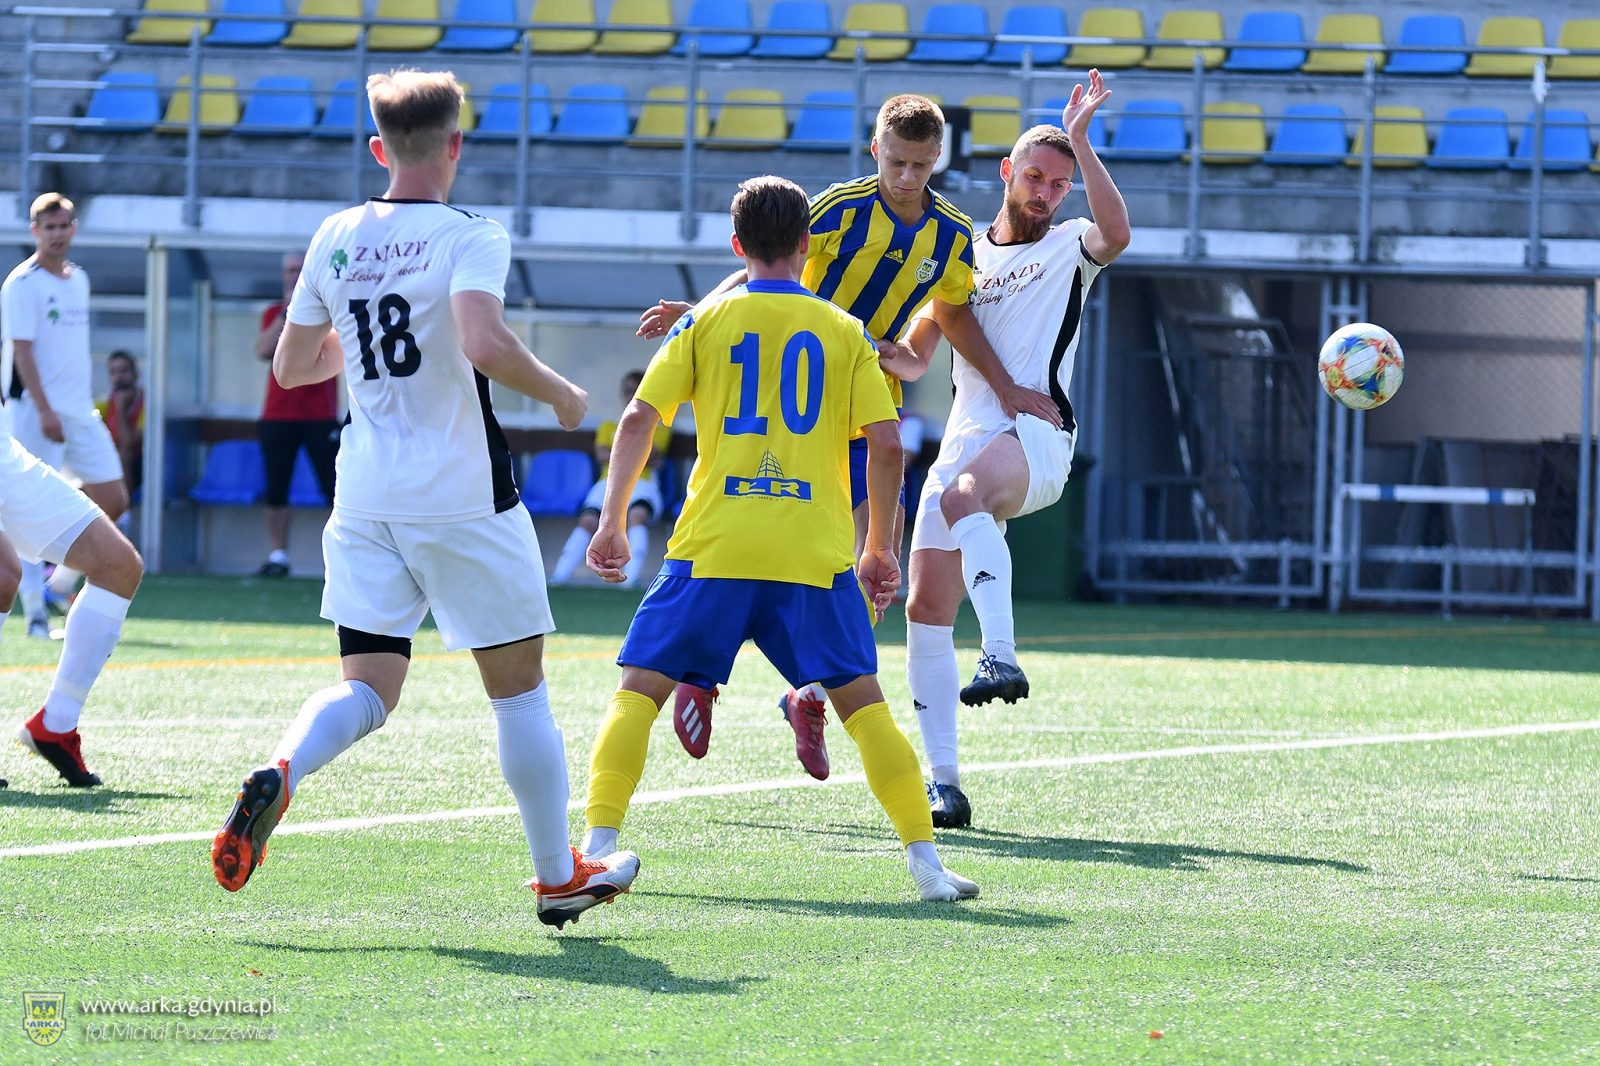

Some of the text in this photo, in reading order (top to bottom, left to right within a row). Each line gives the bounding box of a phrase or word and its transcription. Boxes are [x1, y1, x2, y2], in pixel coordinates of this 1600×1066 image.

[345, 265, 386, 286] Leśny
[981, 262, 1041, 290] ZAJAZD
[1007, 268, 1048, 298] Dwek
[348, 292, 422, 381] 18
[723, 329, 826, 437] 10
